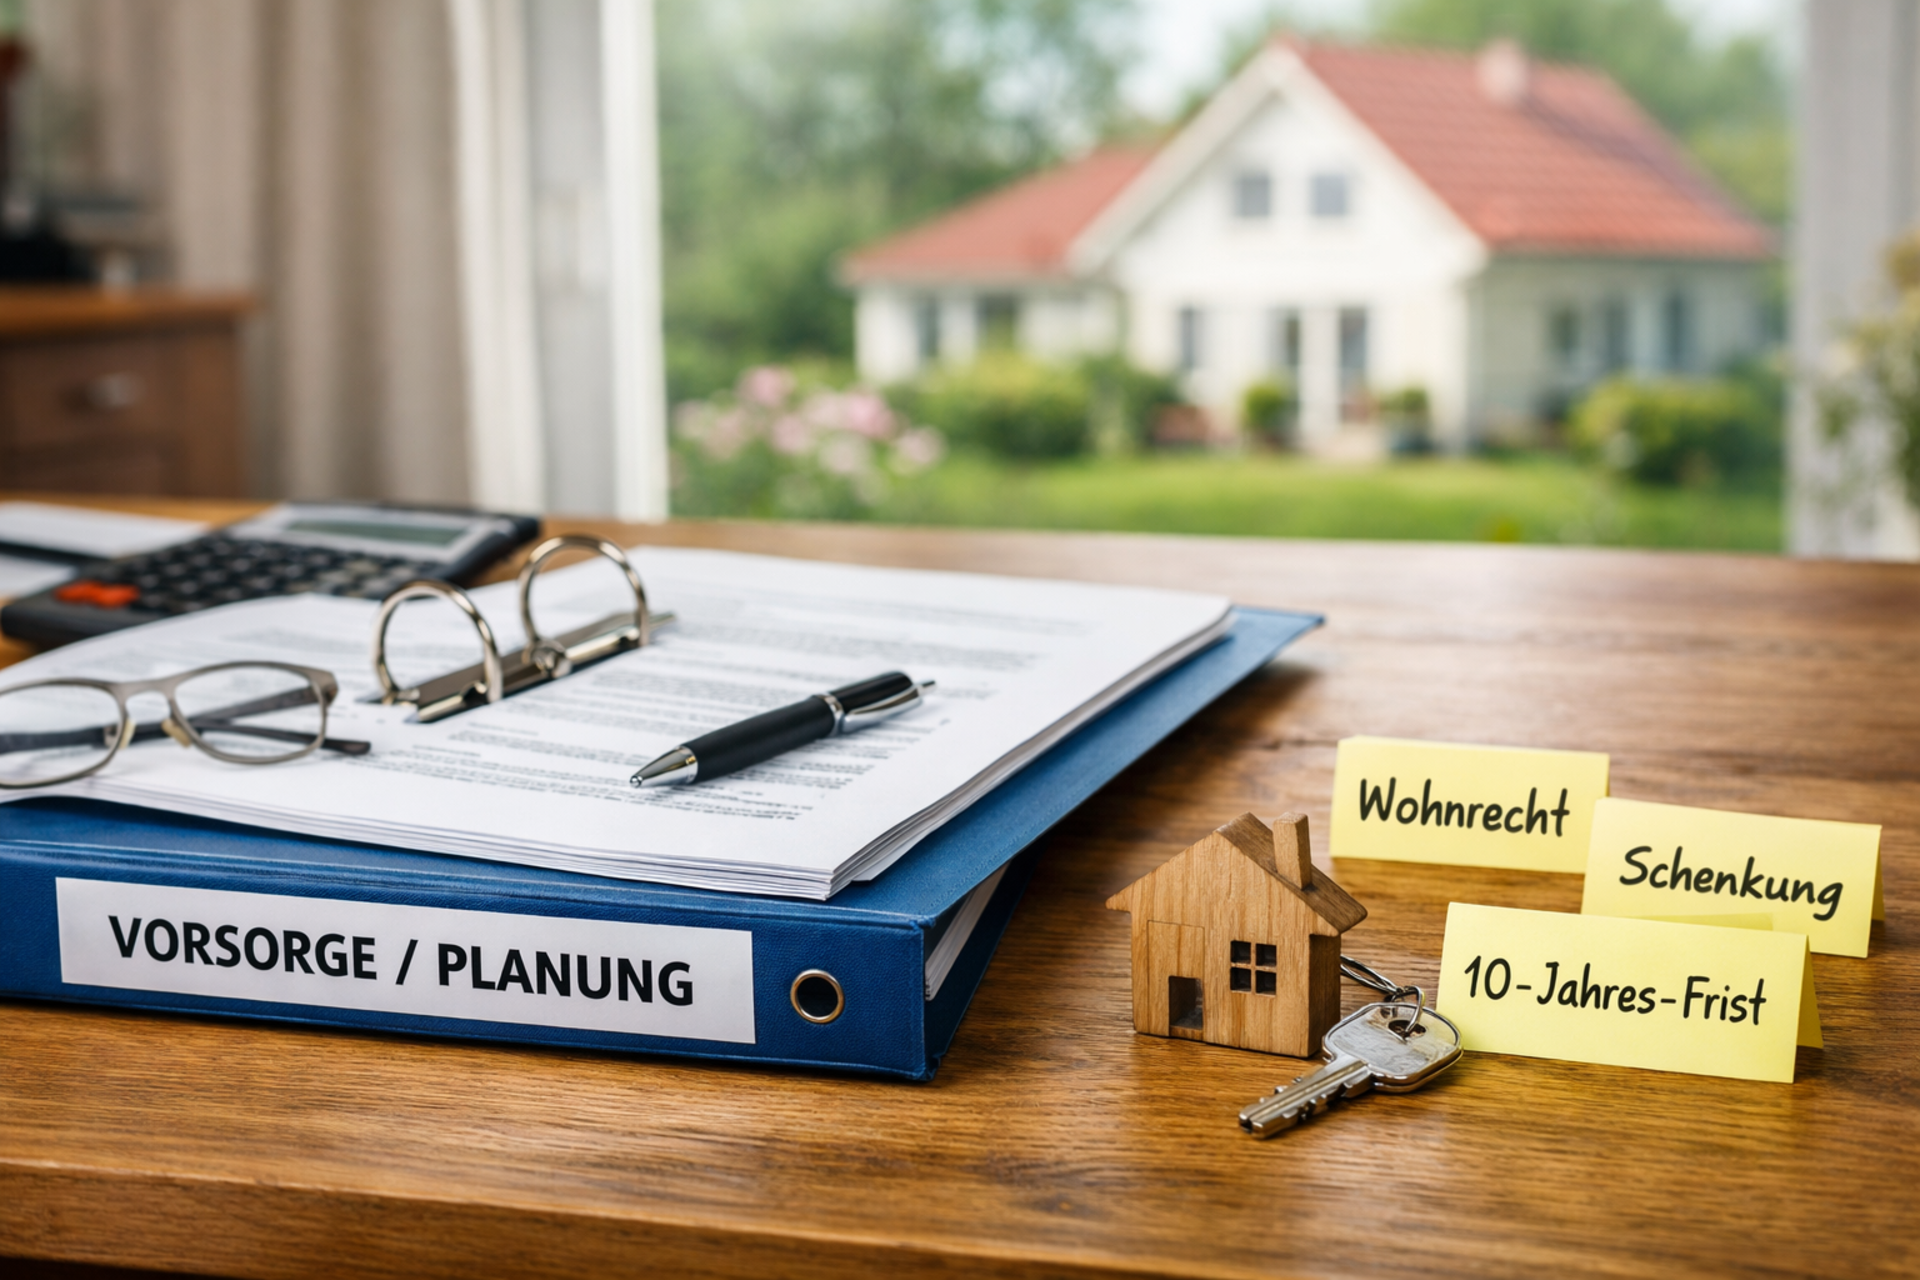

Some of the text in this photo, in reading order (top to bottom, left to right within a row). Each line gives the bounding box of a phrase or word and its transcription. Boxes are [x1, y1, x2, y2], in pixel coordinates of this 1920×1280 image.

[1359, 777, 1570, 837] Wohnrecht
[1619, 845, 1844, 922] Schenkung
[108, 915, 694, 1007] VORSORGE / PLANUNG
[1464, 955, 1767, 1026] 10-Jahres-Frist
